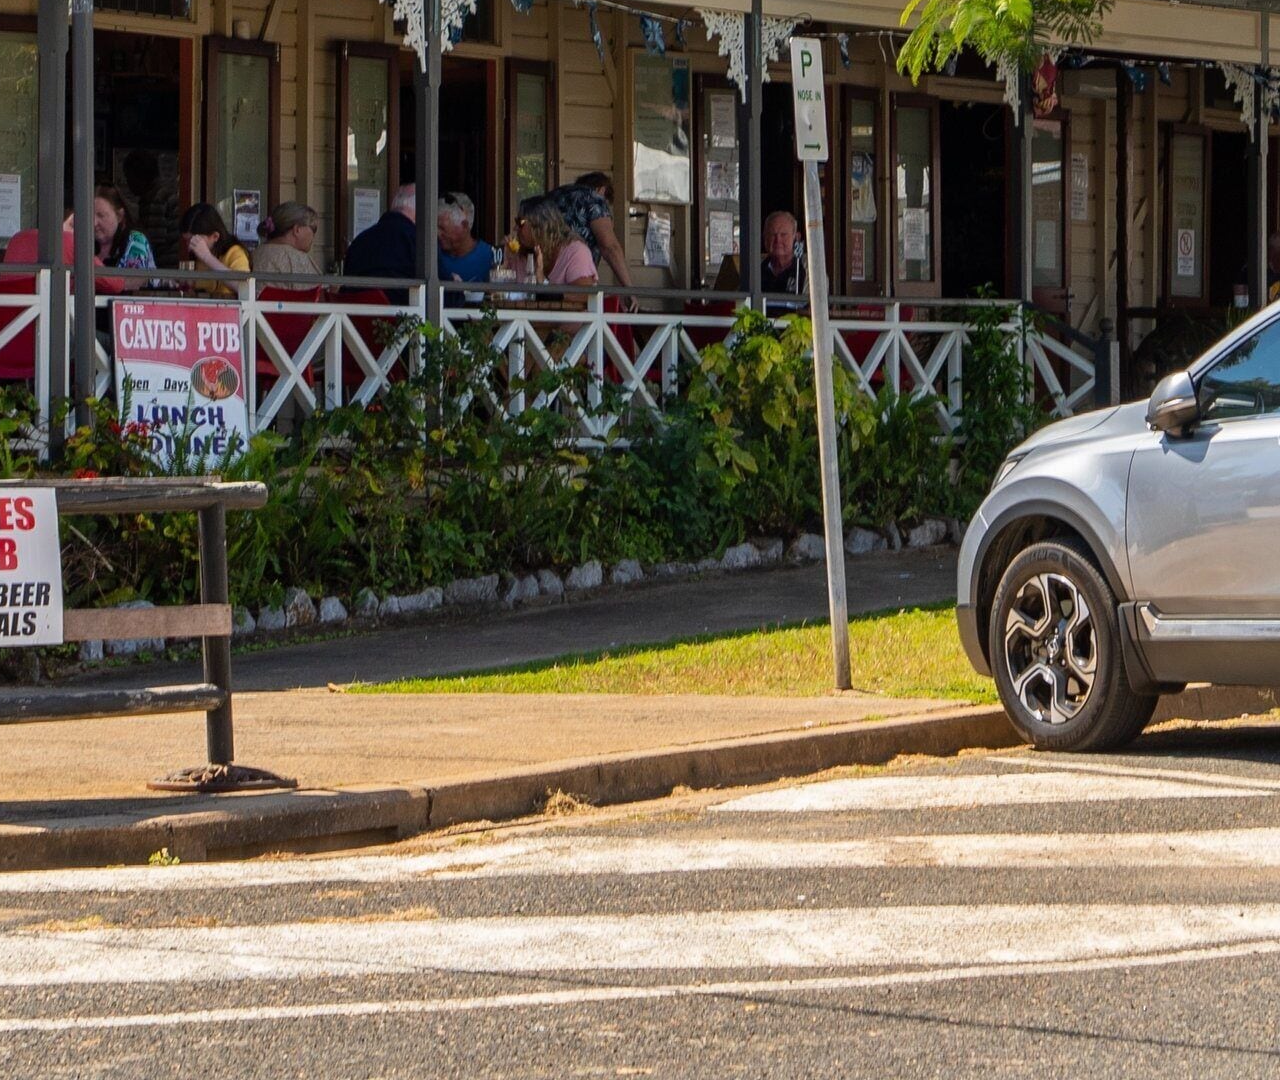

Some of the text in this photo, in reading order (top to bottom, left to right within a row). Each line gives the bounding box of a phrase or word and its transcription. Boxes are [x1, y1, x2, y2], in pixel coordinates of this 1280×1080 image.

[801, 50, 813, 78] P
[798, 89, 822, 101] NOSE IN
[123, 304, 145, 315] THE
[120, 317, 241, 353] CAVES PUB
[164, 377, 189, 393] Days
[137, 404, 225, 426] LUNCH
